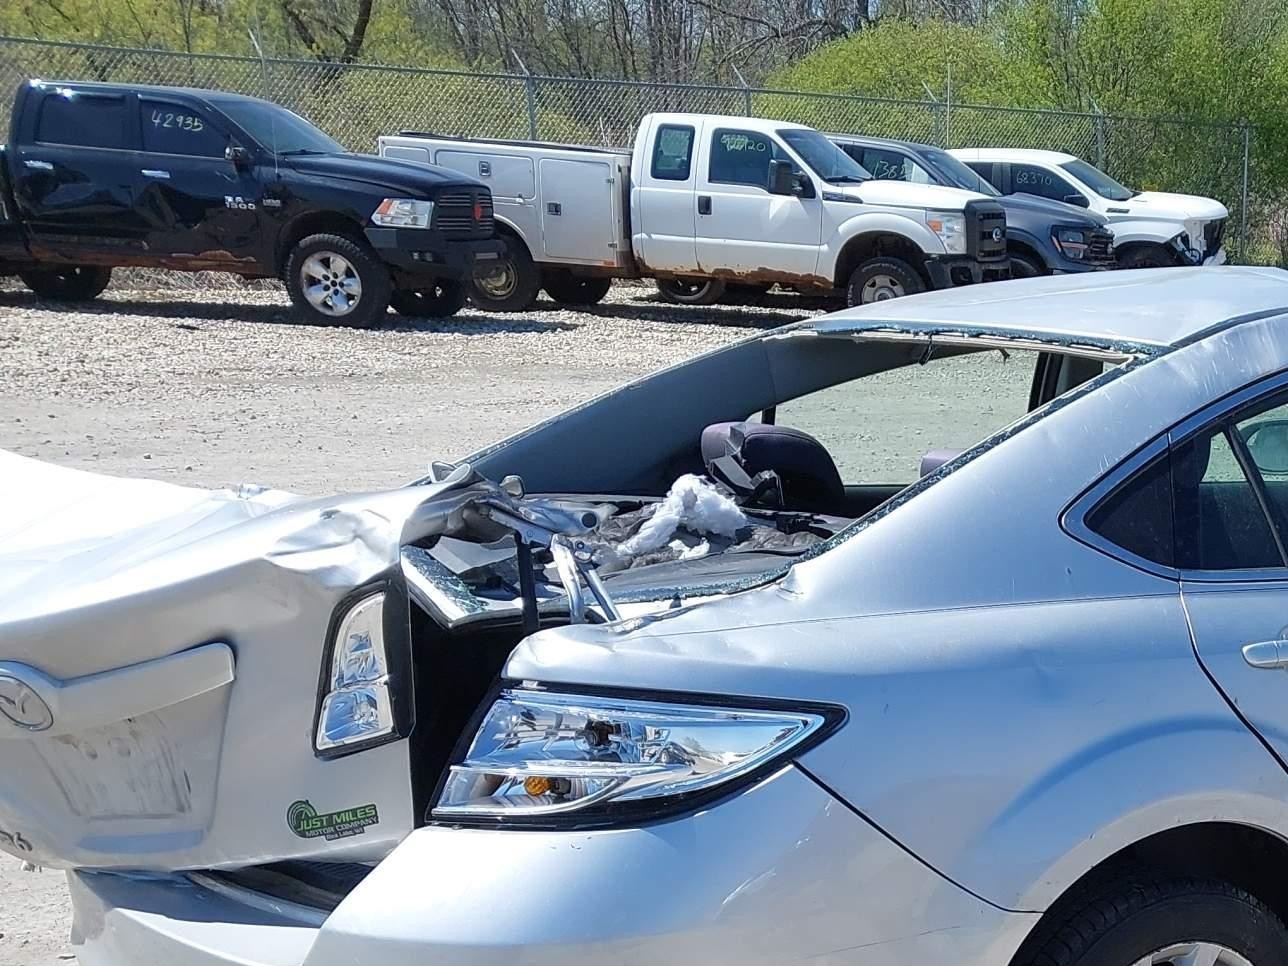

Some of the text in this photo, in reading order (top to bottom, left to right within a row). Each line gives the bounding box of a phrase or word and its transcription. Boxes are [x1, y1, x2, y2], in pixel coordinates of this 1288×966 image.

[152, 110, 203, 131] 42935
[297, 805, 376, 831] JUST MILES
[305, 816, 377, 838] MOTOR COMPANY
